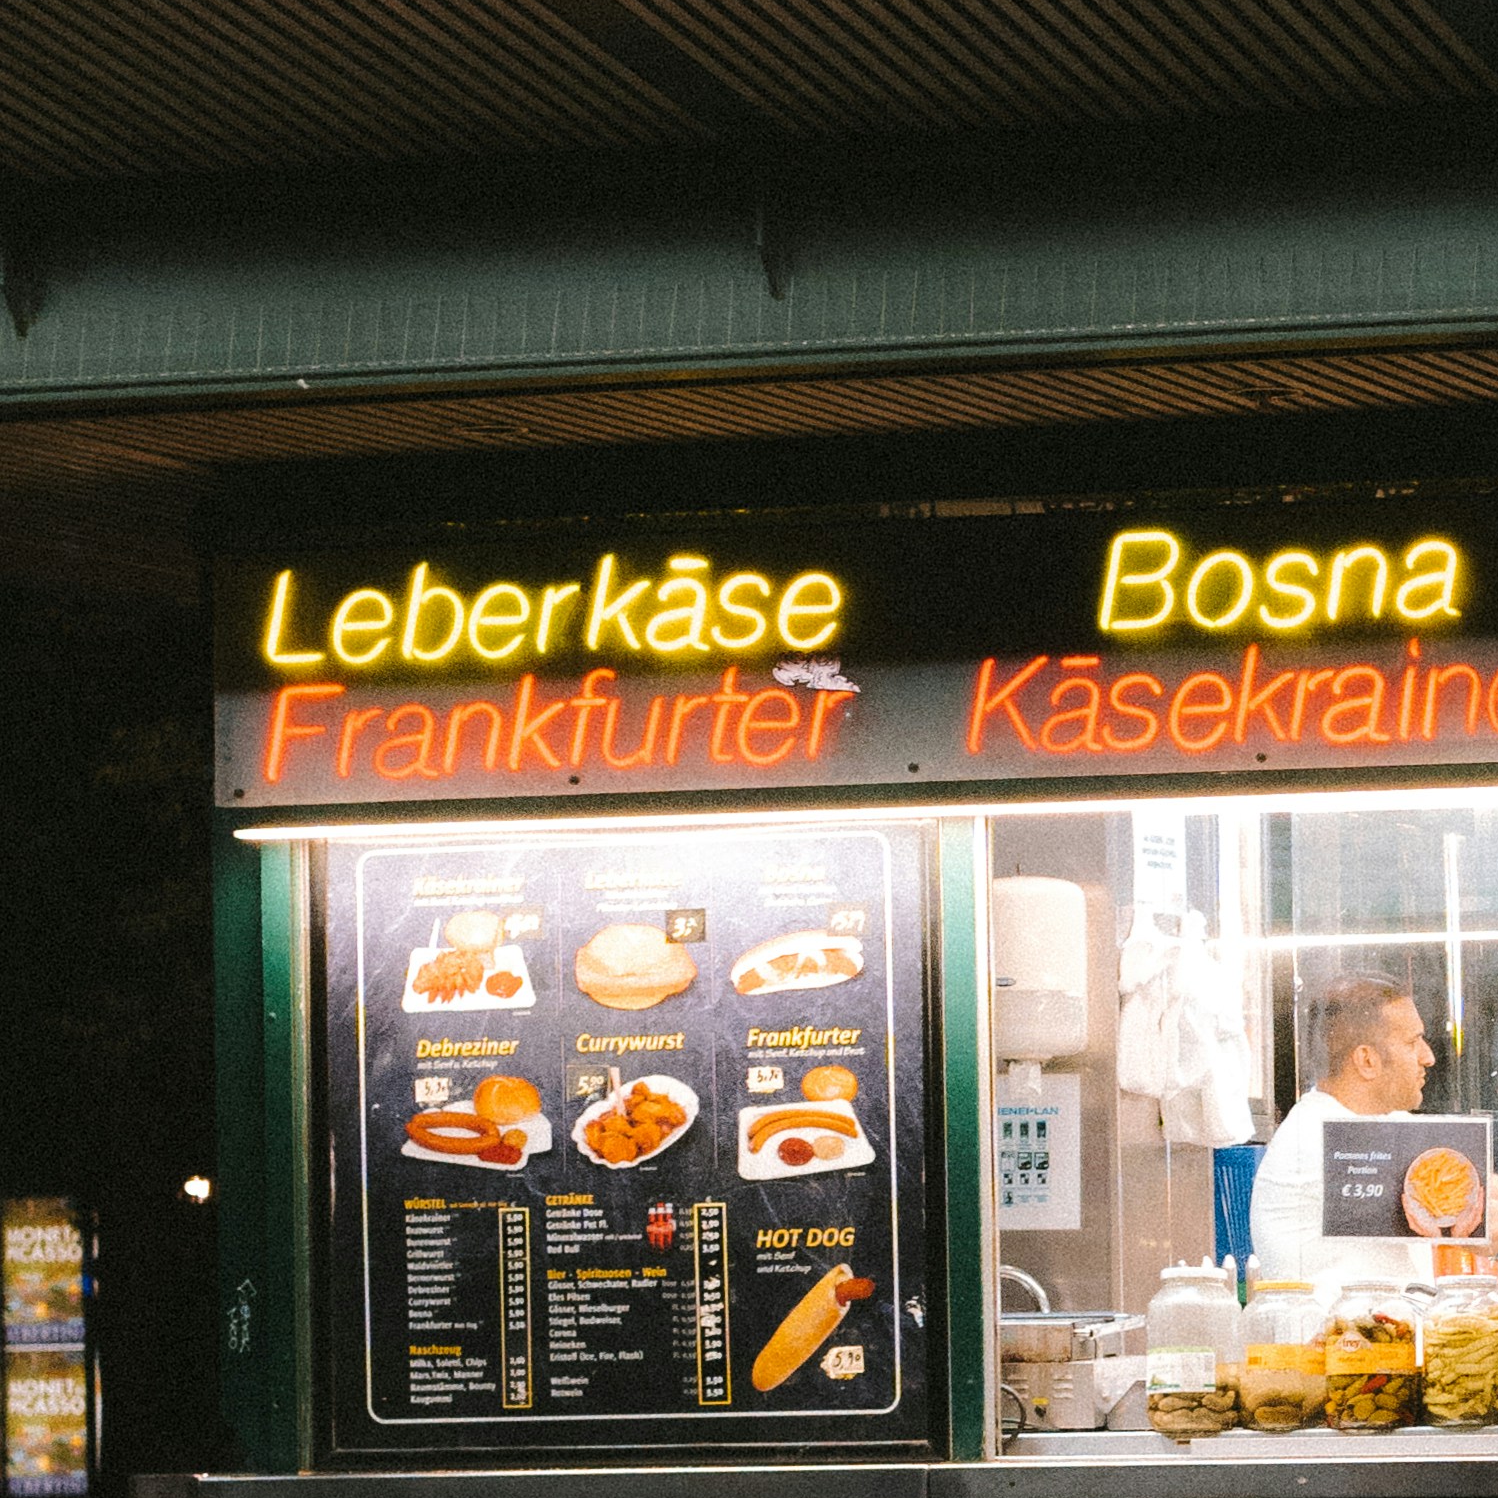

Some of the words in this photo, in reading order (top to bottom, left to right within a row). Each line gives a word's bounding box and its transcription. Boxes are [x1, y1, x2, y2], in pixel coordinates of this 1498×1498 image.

[1097, 529, 1463, 633] Bosna
[264, 666, 856, 783] Frankfurter
[416, 1037, 519, 1059] Debreziner
[576, 1031, 685, 1055] Currywurst
[747, 1026, 861, 1050] Frankfurter
[545, 1193, 594, 1206] GETRÄNKE
[1341, 1184, 1352, 1197] €
[1353, 1184, 1384, 1199] 3,90
[404, 1197, 446, 1210] WÜRSTEL
[755, 1228, 802, 1248] HOT
[806, 1227, 856, 1247] DOG
